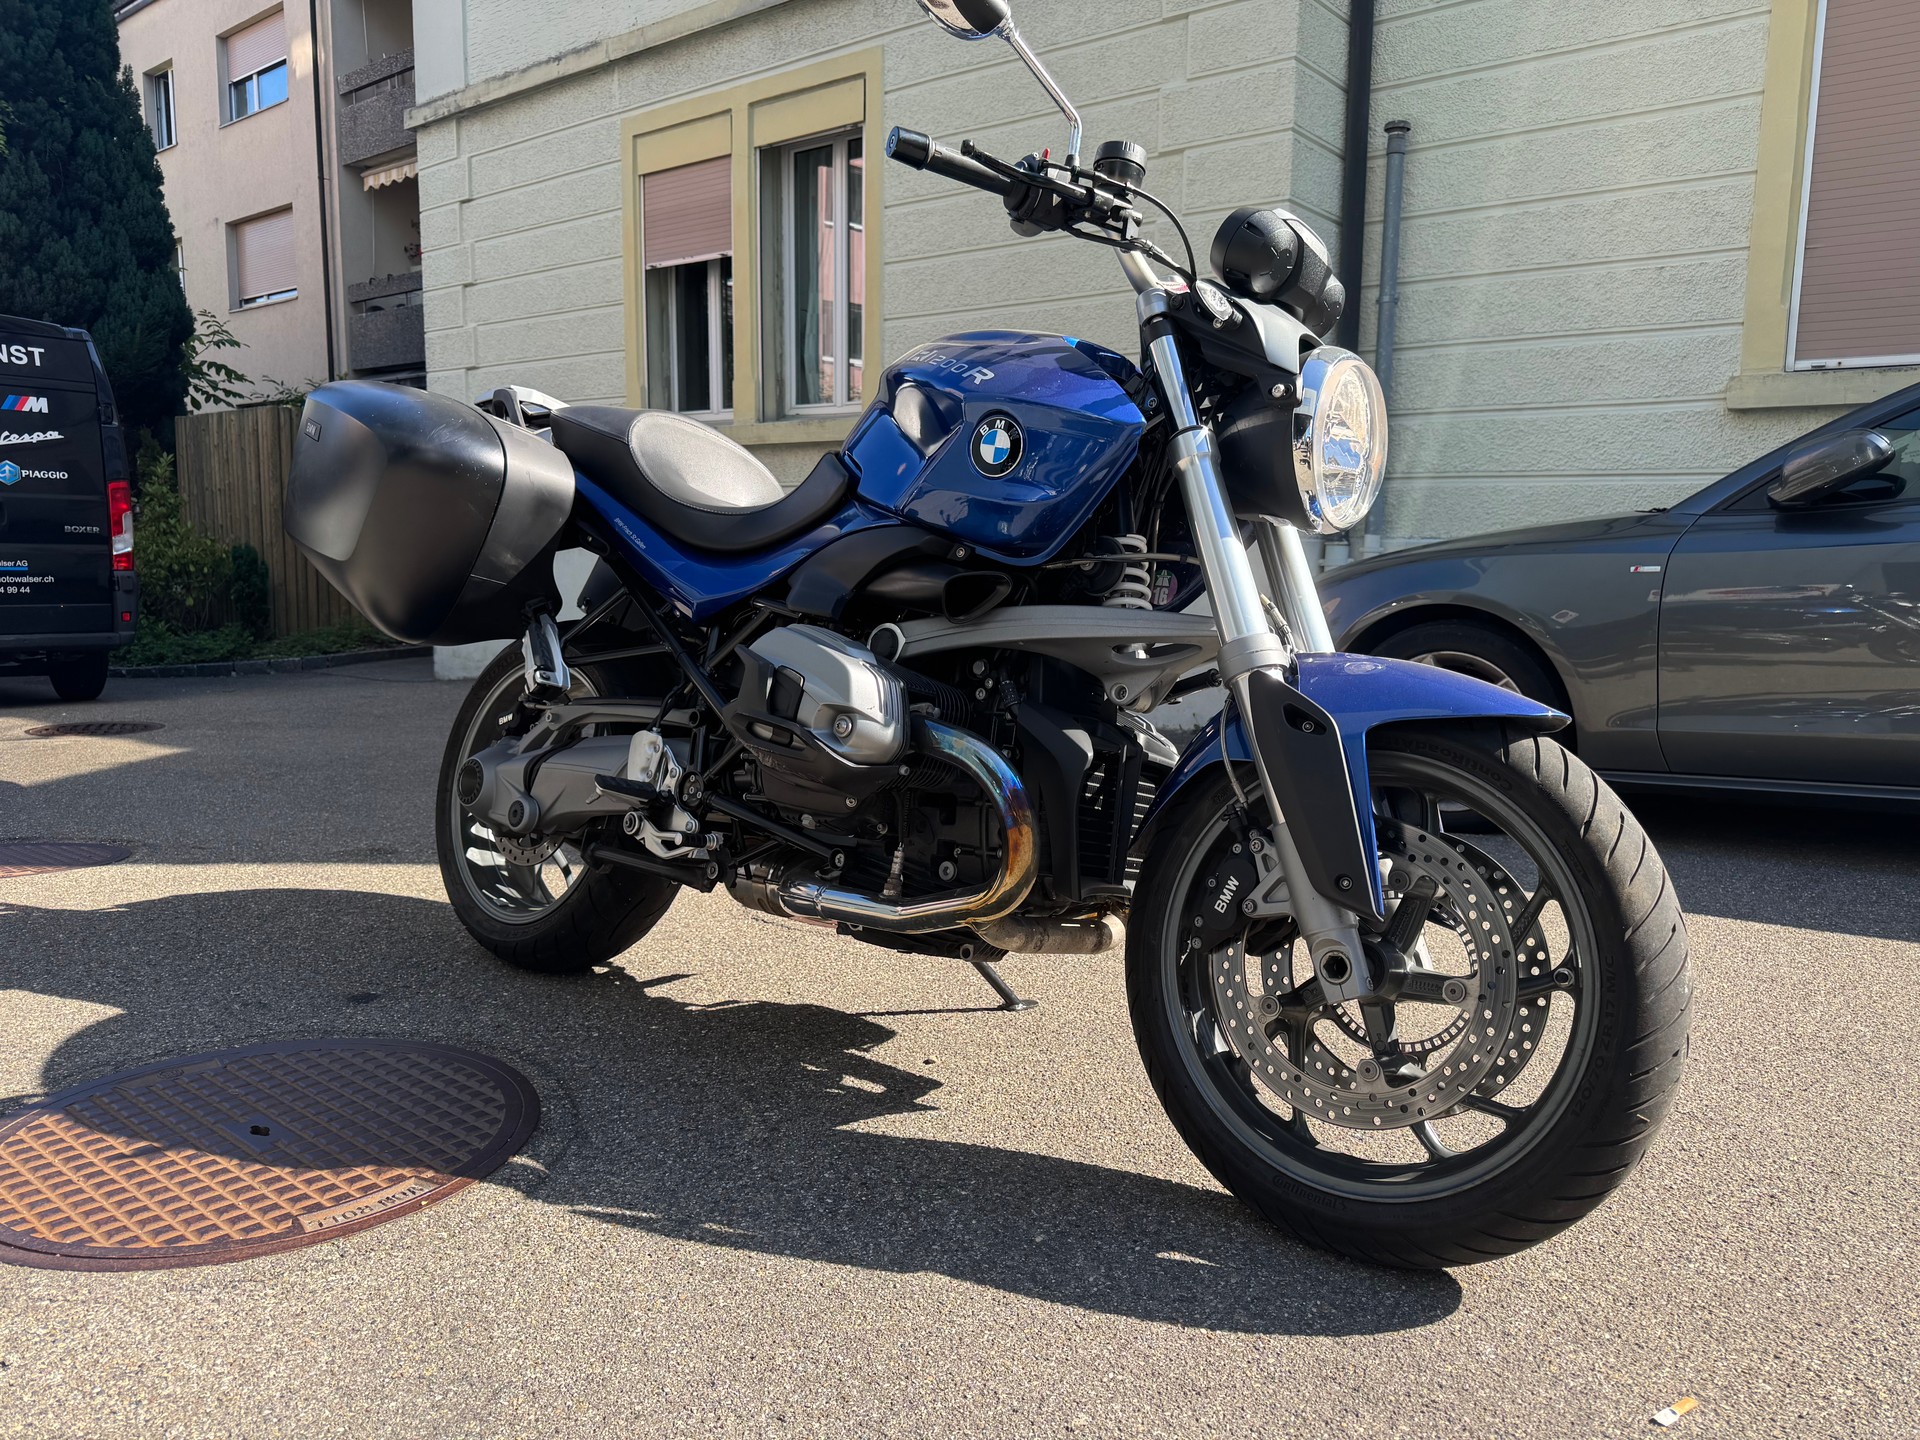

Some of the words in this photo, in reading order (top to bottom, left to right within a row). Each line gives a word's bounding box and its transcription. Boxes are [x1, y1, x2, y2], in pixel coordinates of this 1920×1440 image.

[979, 419, 1020, 441] BMW
[21, 469, 68, 481] PIAGGIO
[64, 525, 100, 534] BOXER
[0, 575, 55, 583] otowalser.ch
[6, 586, 18, 594] 99
[19, 586, 30, 594] 44
[1153, 587, 1169, 605] 16
[498, 713, 513, 725] BMW
[1213, 875, 1240, 914] BMW
